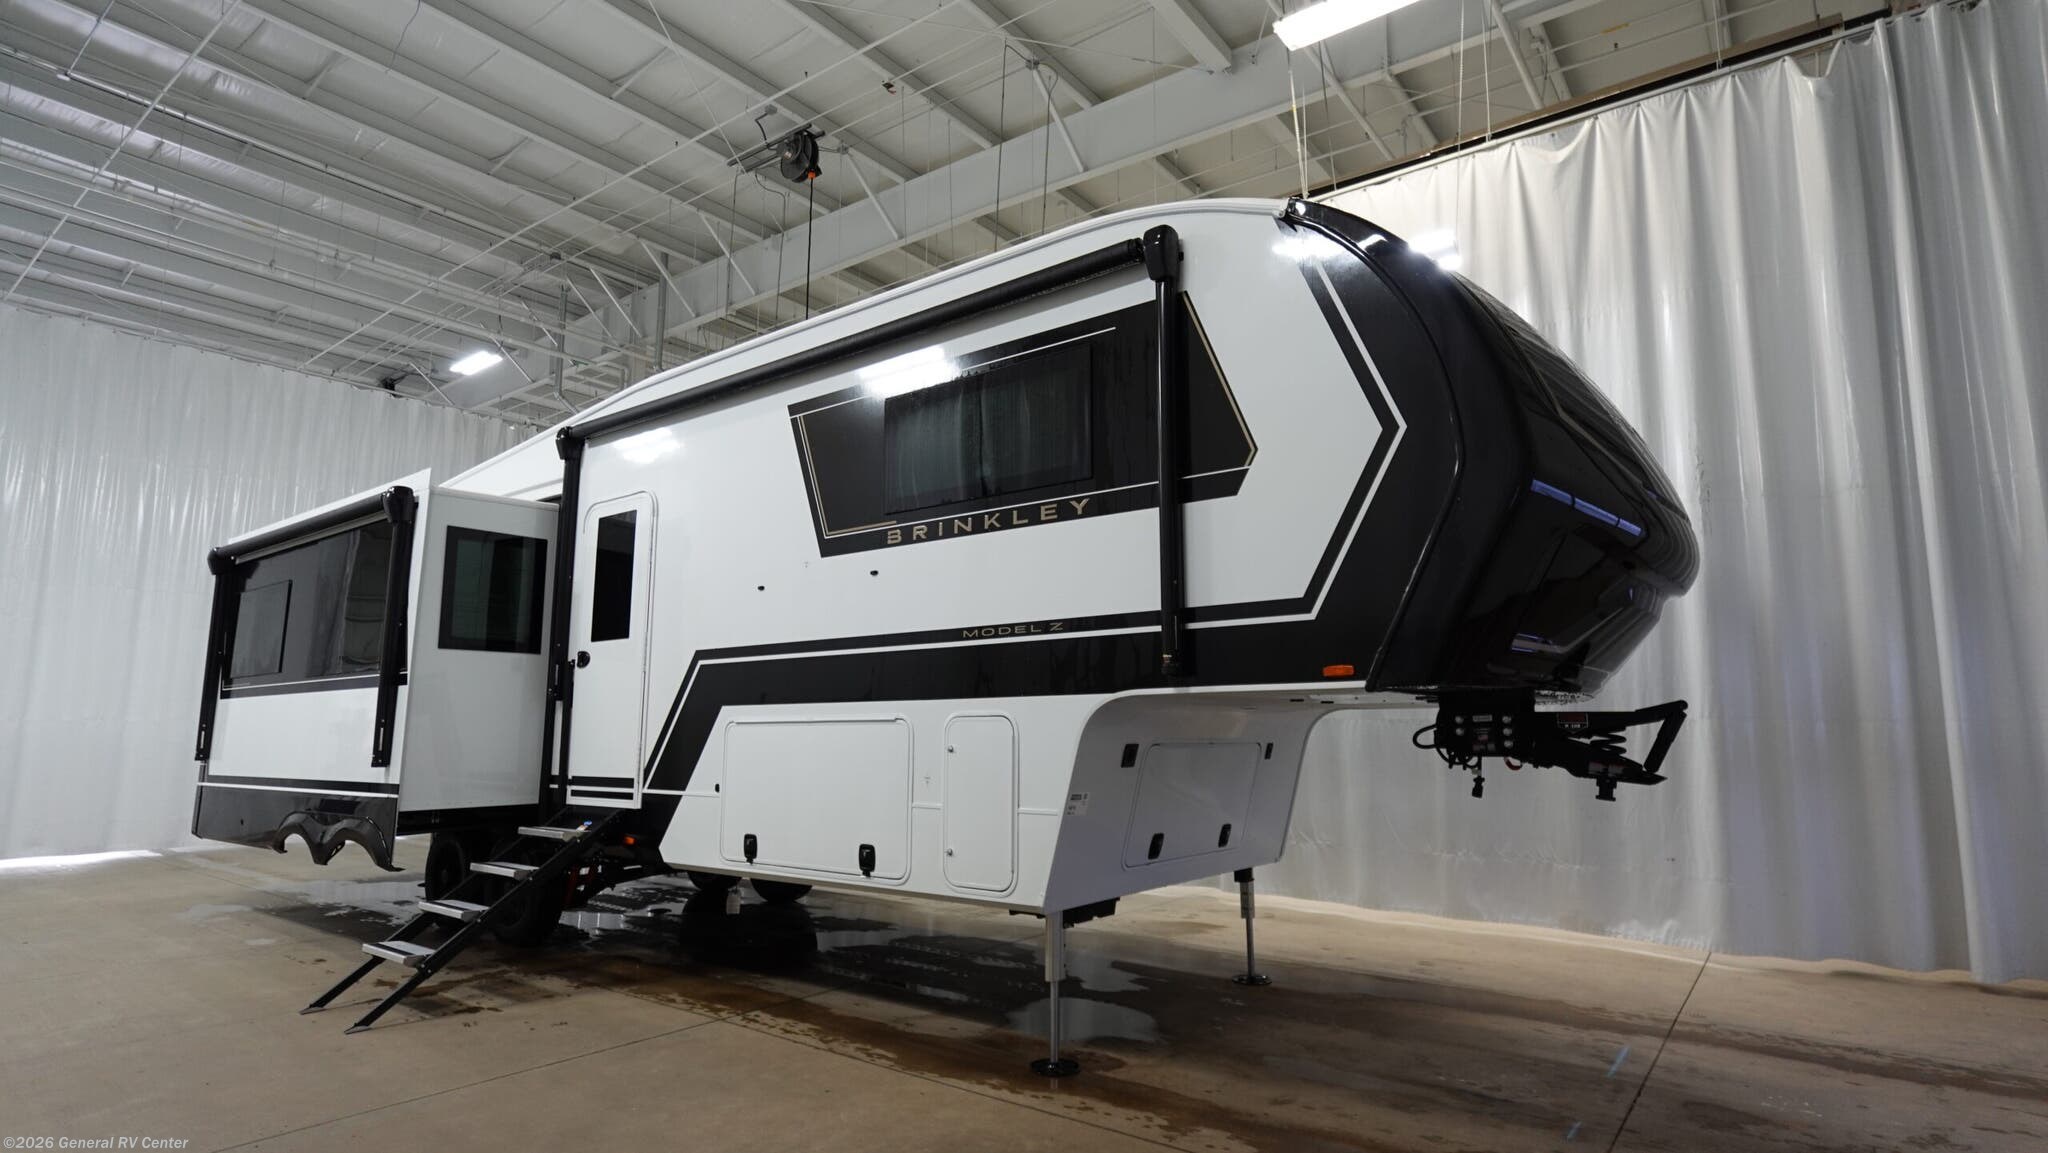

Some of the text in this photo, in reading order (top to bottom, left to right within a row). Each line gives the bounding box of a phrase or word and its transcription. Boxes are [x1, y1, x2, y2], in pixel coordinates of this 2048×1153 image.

[887, 498, 1090, 545] BRINKLEY
[962, 622, 1064, 638] MODEL Z
